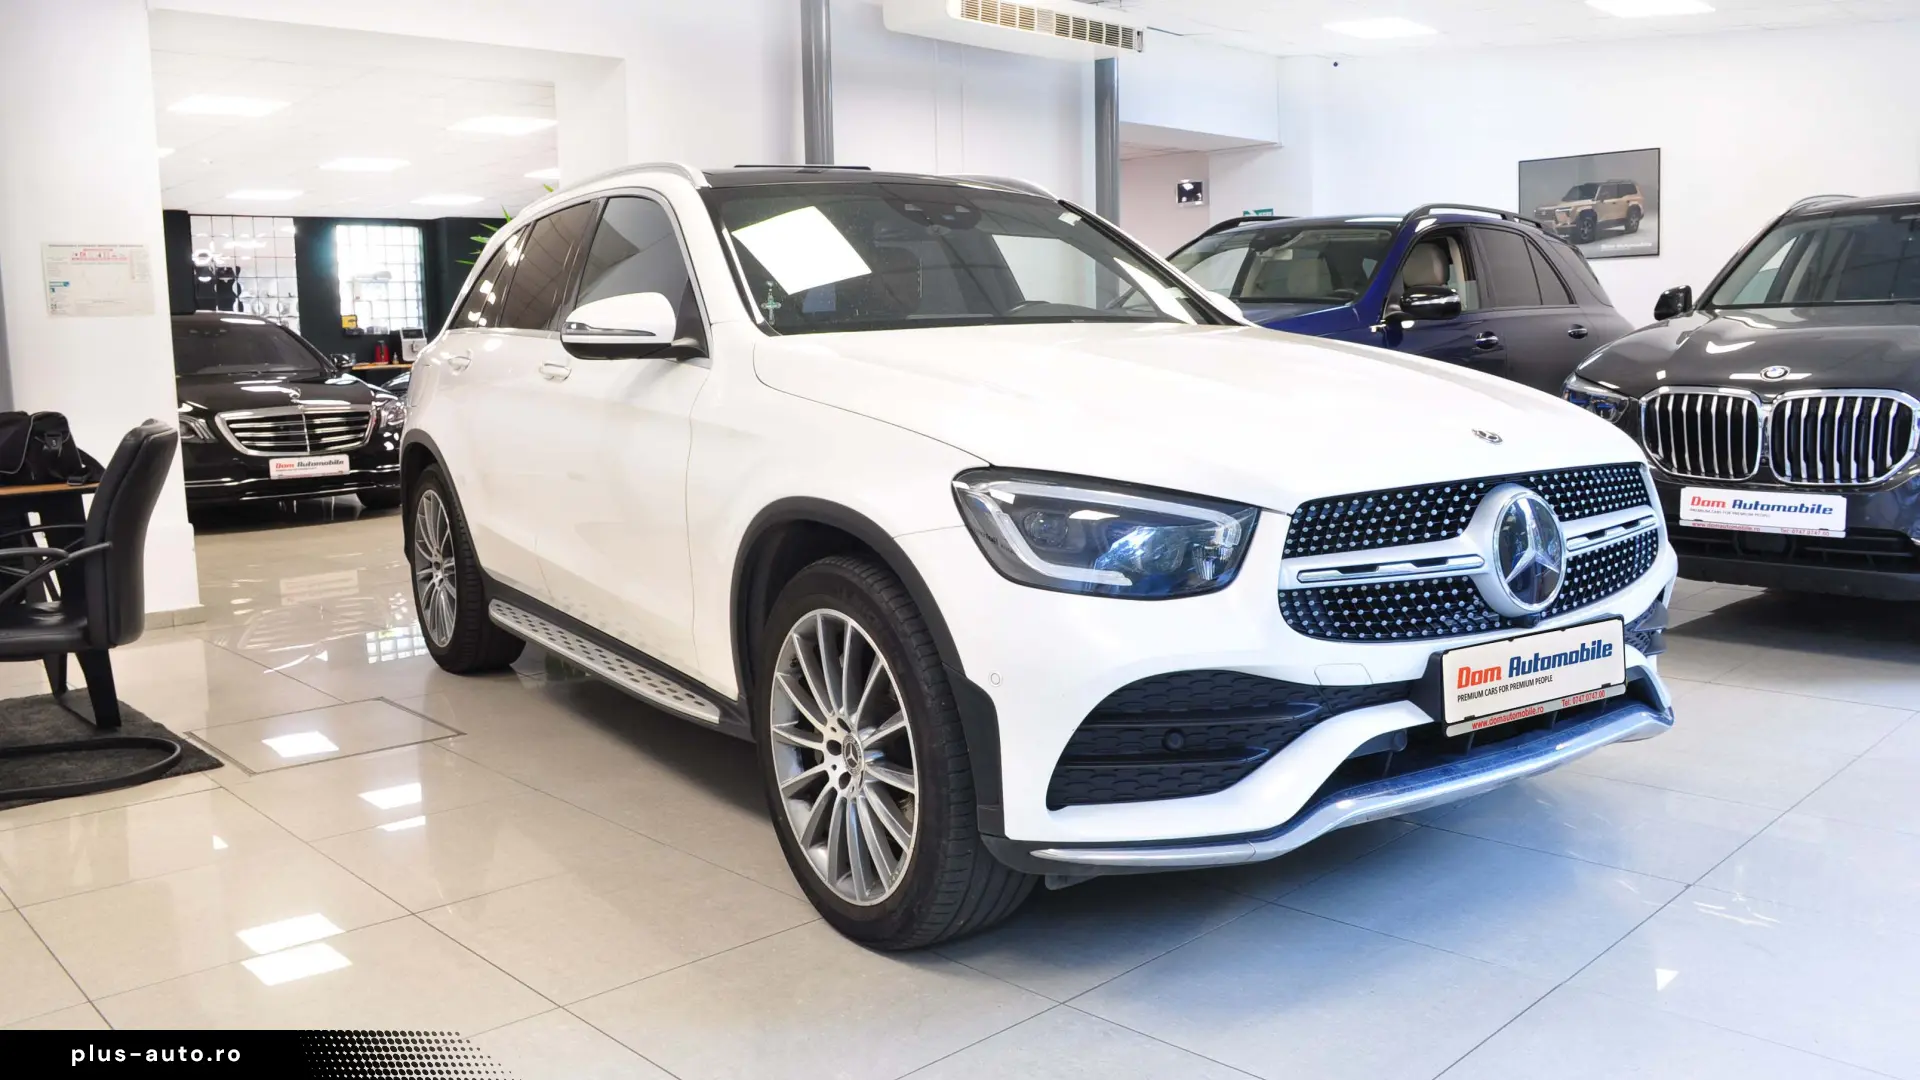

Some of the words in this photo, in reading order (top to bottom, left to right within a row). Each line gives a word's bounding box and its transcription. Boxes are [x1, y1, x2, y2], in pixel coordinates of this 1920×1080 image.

[1690, 495, 1726, 508] Dom
[1732, 499, 1834, 515] Automobile
[1457, 666, 1502, 689] Dom
[1508, 639, 1613, 678] Automobile
[1457, 690, 1484, 703] PREMIUM
[1484, 687, 1498, 697] CARS
[1498, 685, 1509, 694] FOR
[1509, 679, 1534, 692] PREMIUM
[1535, 674, 1553, 685] PEOPLE
[1471, 706, 1544, 730] www.domautomobile.ro
